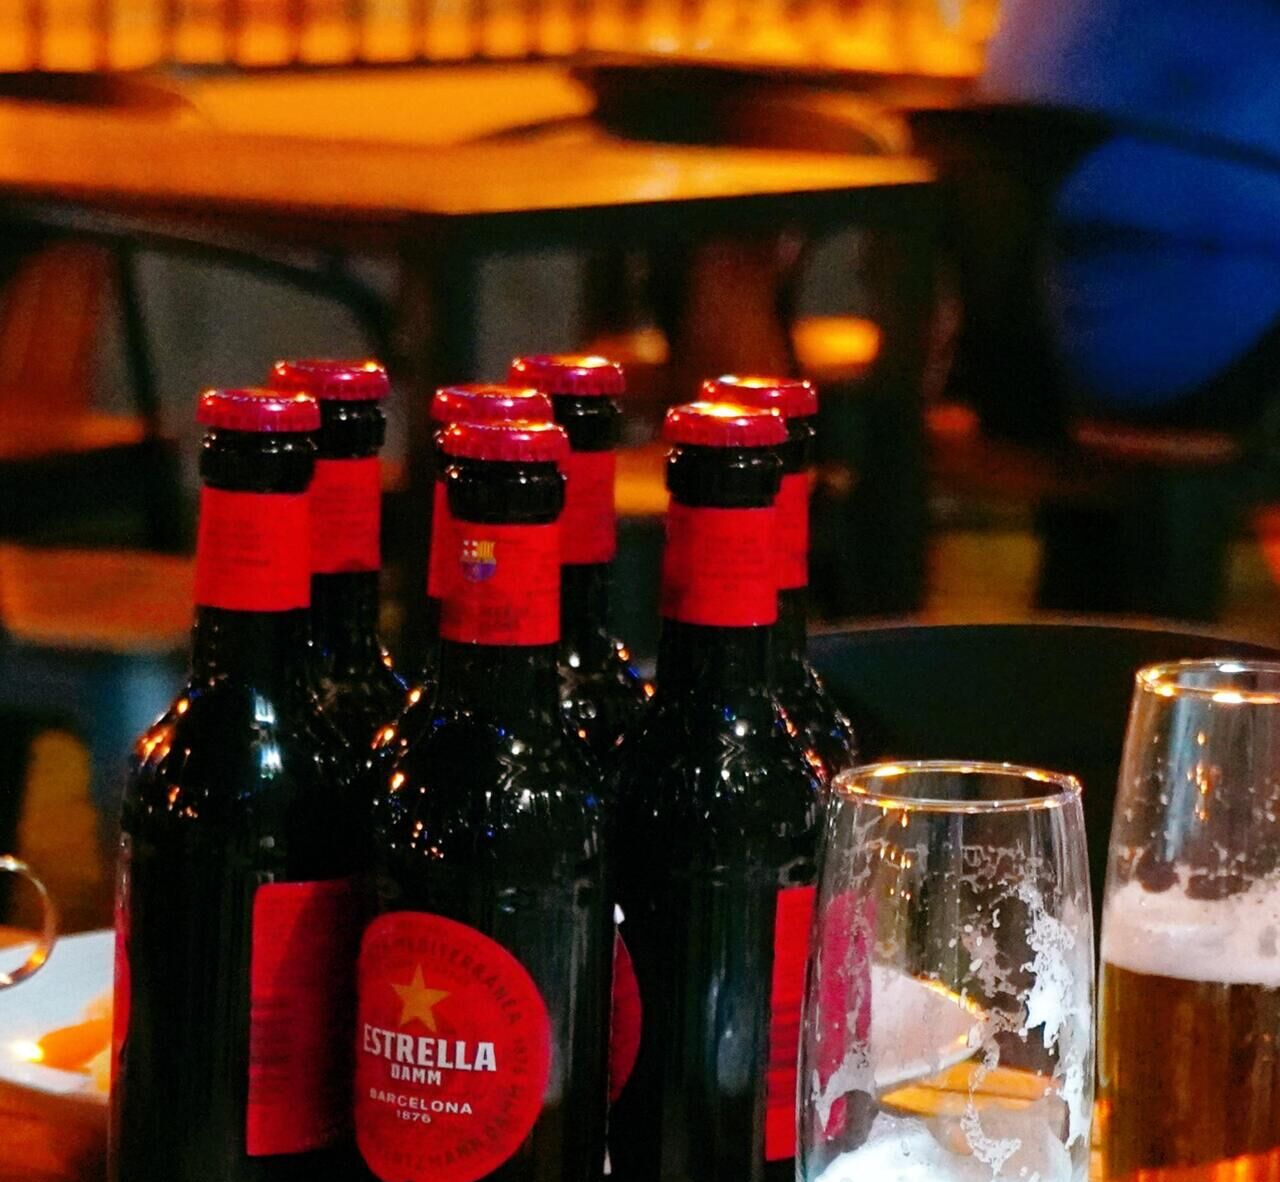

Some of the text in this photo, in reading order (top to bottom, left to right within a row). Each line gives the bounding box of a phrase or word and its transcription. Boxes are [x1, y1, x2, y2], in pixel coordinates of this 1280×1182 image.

[364, 1023, 497, 1072] ESTRELLA
[391, 1063, 442, 1086] DAMM
[370, 1087, 473, 1115] BARCELONA
[396, 1109, 432, 1124] 1876
